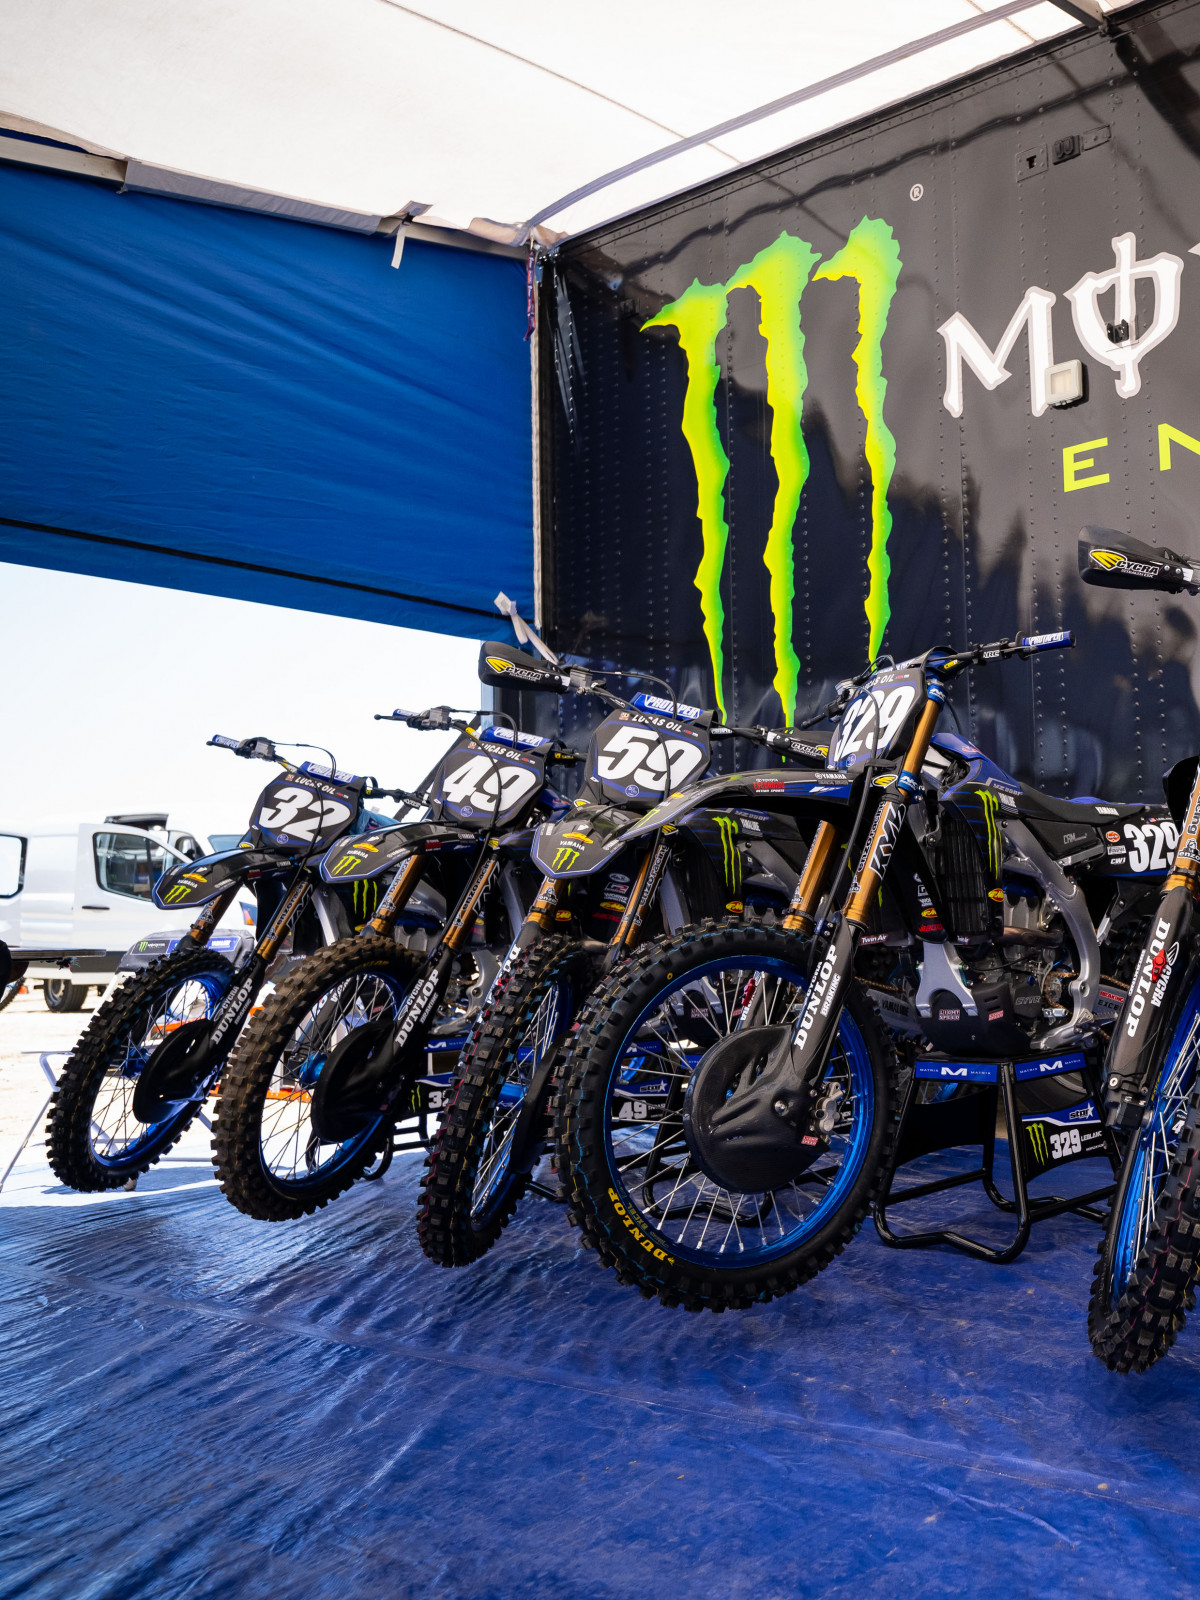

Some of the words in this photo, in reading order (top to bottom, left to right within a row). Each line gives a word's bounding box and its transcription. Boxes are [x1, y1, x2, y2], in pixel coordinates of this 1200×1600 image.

[1117, 560, 1160, 576] CYCRA
[1029, 632, 1064, 646] PROTAPER
[505, 666, 543, 681] CYCRA
[880, 673, 894, 684] OIL
[665, 721, 682, 733] OIL
[833, 685, 916, 762] 329
[505, 750, 521, 761] OIL
[597, 725, 703, 791] 59
[790, 741, 823, 755] CYCRA
[322, 784, 336, 795] OIL
[443, 755, 537, 812] 49
[258, 786, 350, 842] 32
[1094, 806, 1120, 816] YAMAHA
[560, 840, 585, 851] YAMAHA
[1123, 821, 1180, 873] 329
[875, 934, 887, 942] Air
[1125, 917, 1171, 1038] DUNLOP
[1151, 964, 1172, 1008] CYCRA
[222, 985, 240, 1010] CYCRA
[406, 978, 424, 1008] CYCRA
[794, 944, 838, 1051] DUNLOP
[820, 972, 842, 1018] BRAKING
[211, 977, 253, 1045] DUNLOP
[395, 969, 441, 1048] DUNLOP
[619, 1099, 648, 1120] 49
[1050, 1128, 1082, 1160] 329
[1080, 1130, 1103, 1142] LEBLANC
[607, 1187, 669, 1262] DUNLOP
